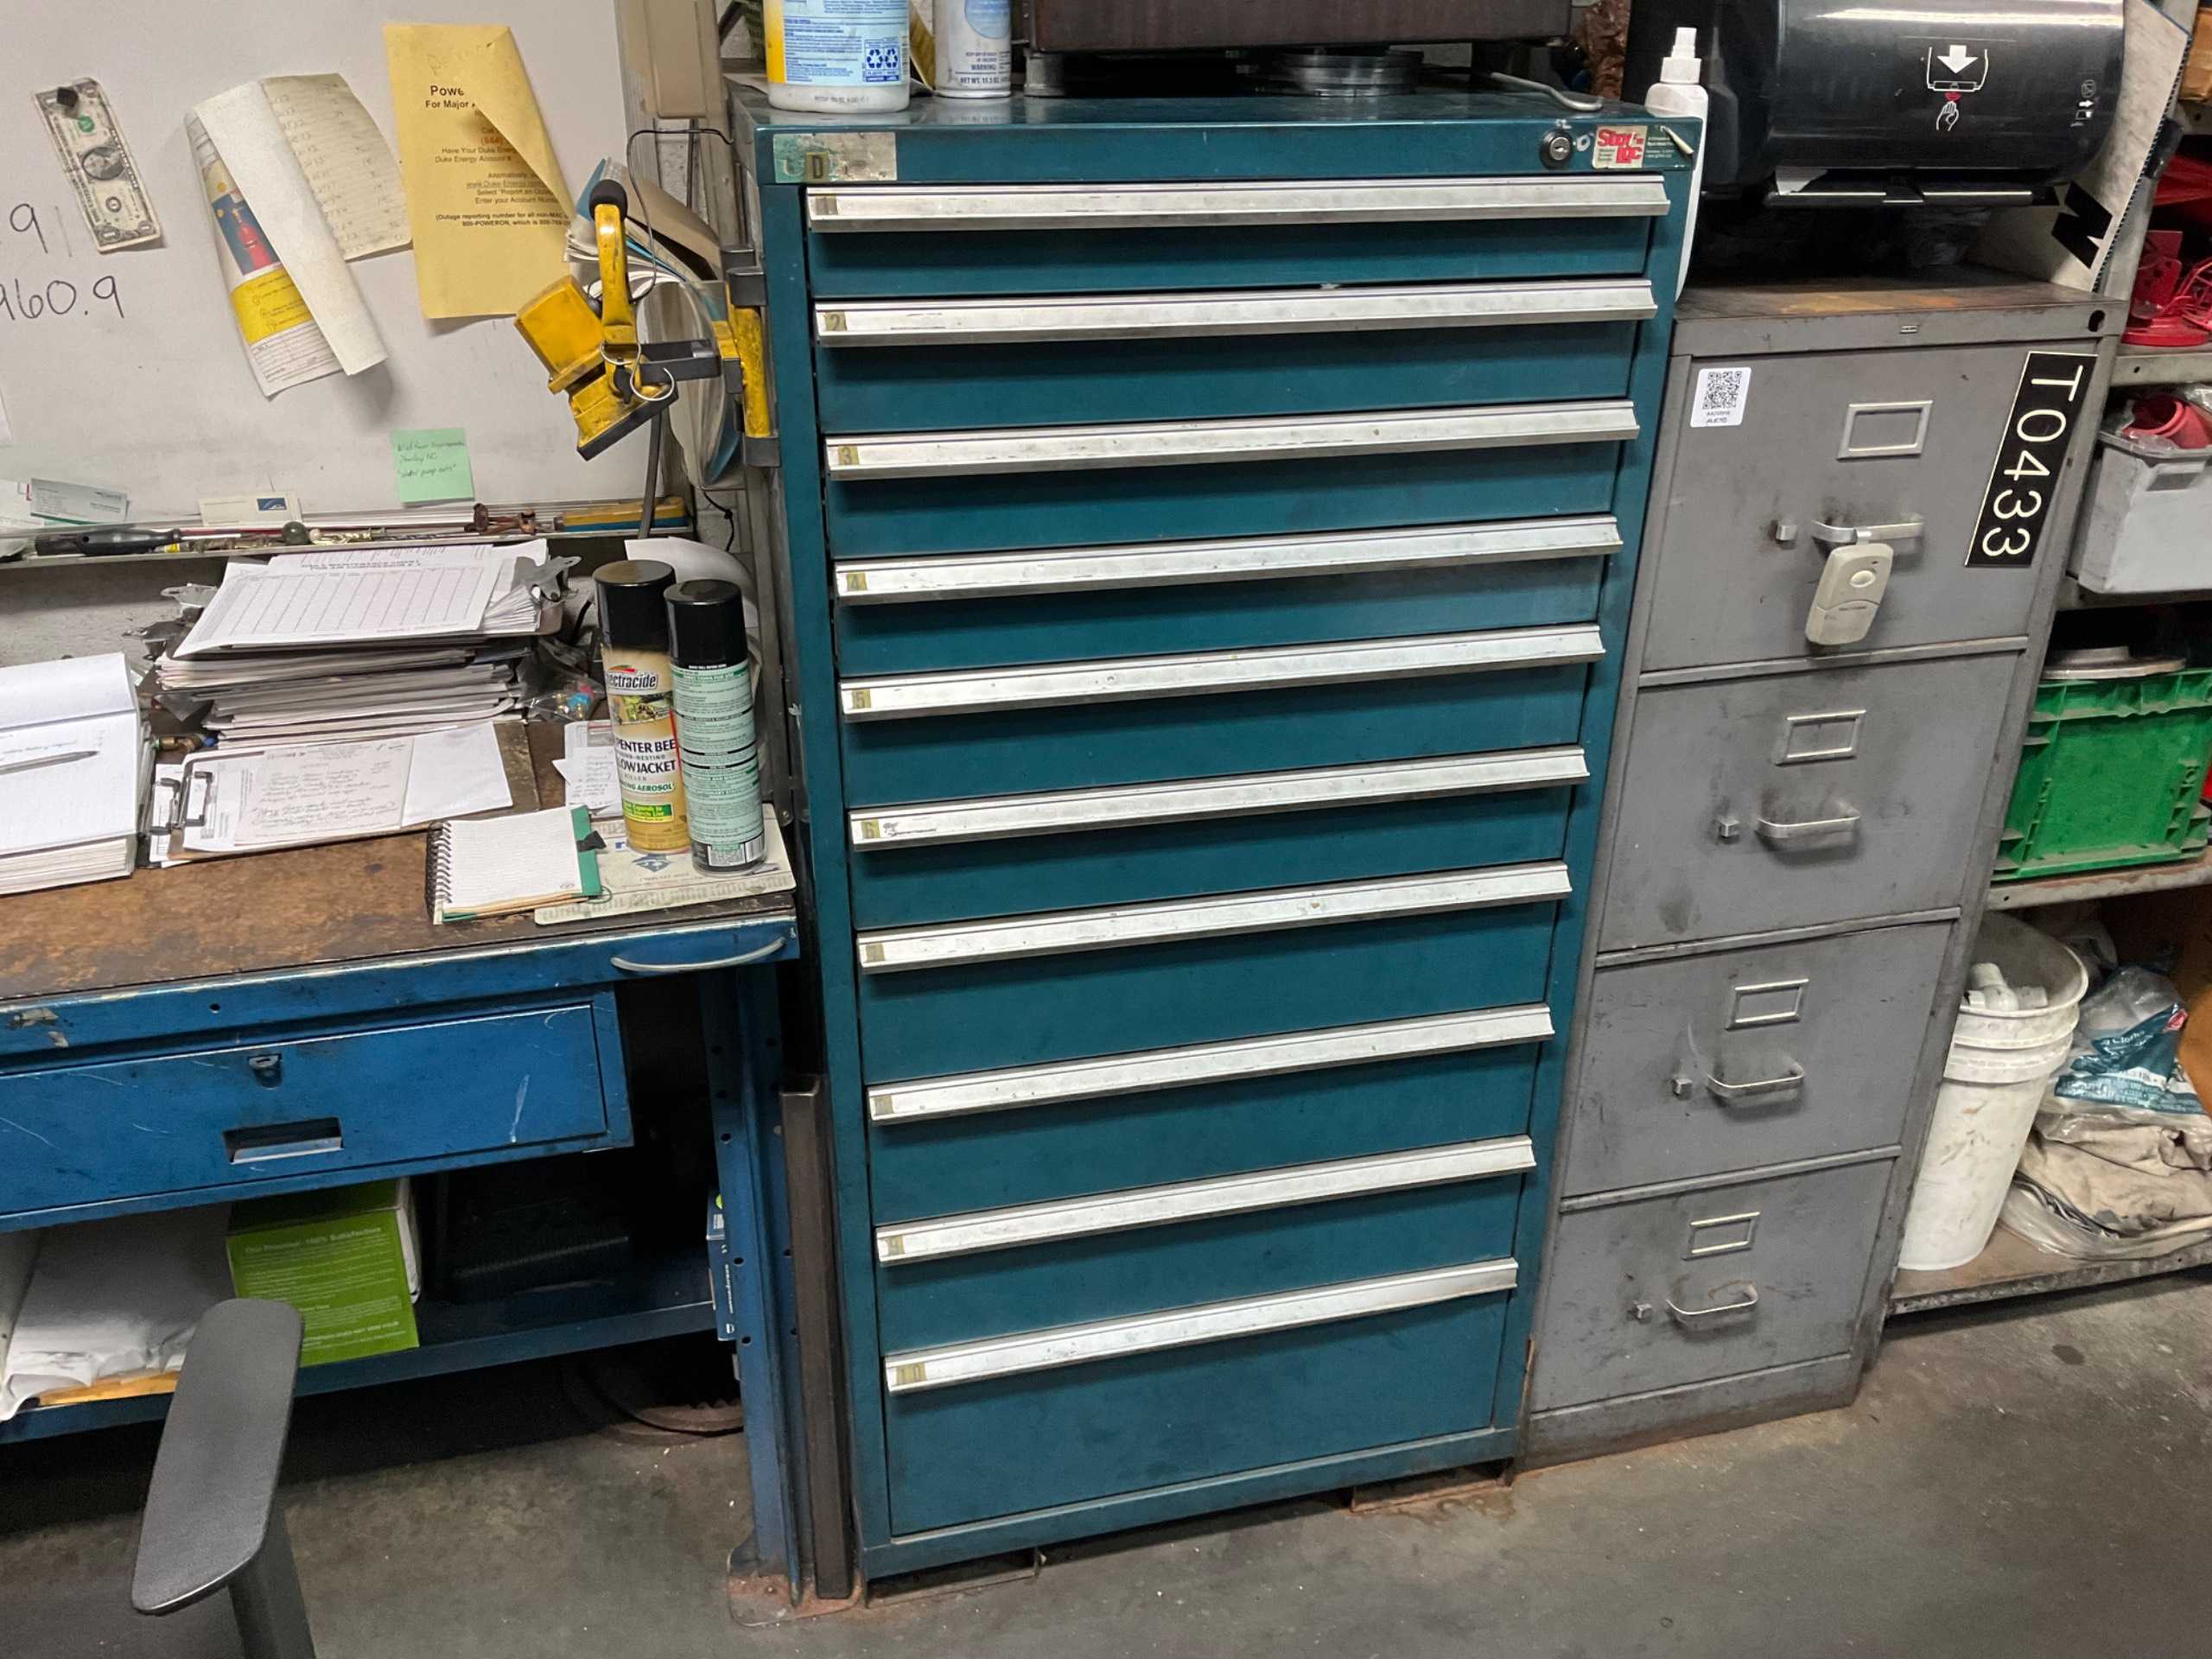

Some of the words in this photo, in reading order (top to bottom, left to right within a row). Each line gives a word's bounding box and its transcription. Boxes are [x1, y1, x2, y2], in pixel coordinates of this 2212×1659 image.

[443, 100, 469, 110] Major
[1981, 364, 2083, 556] T0433
[607, 673, 658, 689] ectracide
[654, 739, 677, 753] BEE
[637, 783, 672, 791] AEROSOL
